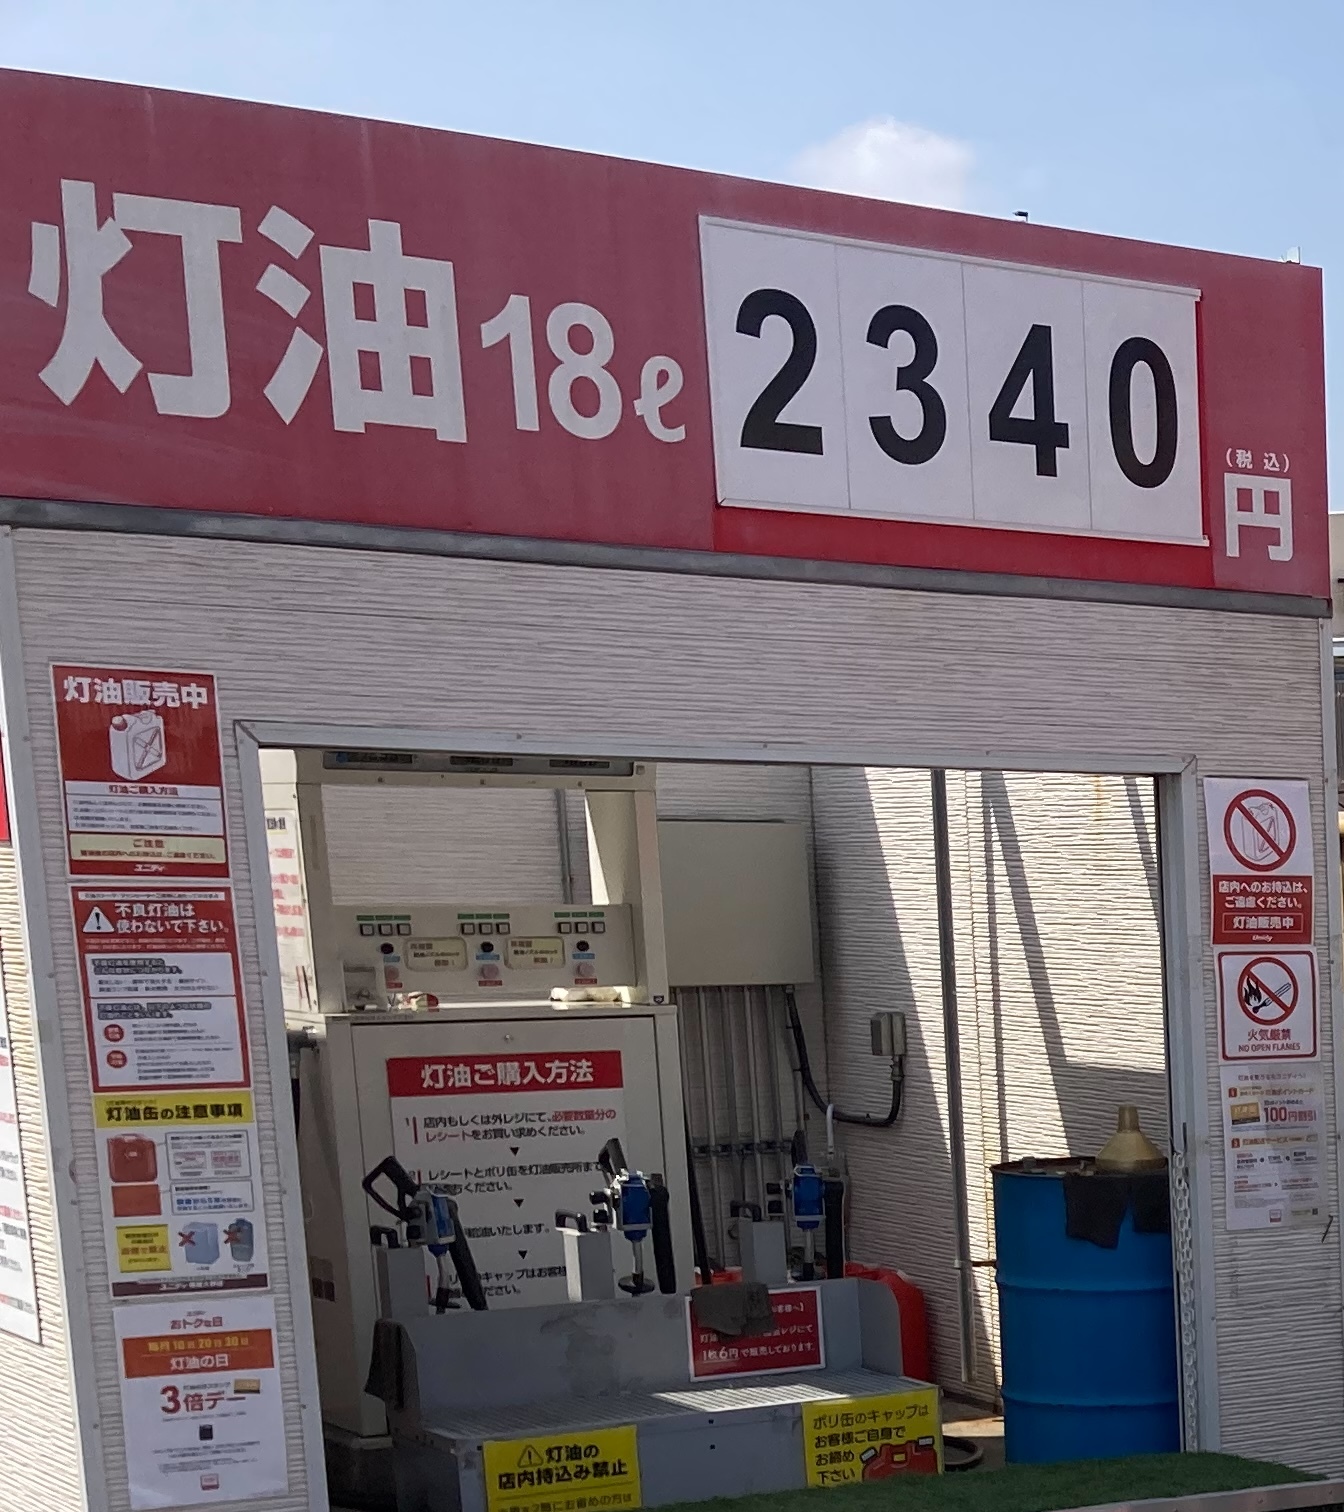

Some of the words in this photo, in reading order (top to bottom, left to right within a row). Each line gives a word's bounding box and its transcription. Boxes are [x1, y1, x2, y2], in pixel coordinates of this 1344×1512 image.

[28, 179, 466, 443] 灯油
[735, 289, 1177, 489] 2340
[1223, 472, 1293, 561] 円
[63, 676, 207, 708] 灯油販売中
[1218, 880, 1308, 894] 店内へのお持込は、
[115, 903, 195, 916] 不良灯油は
[116, 920, 229, 933] 使わないで下さい。
[1232, 915, 1294, 930] 灯油販売中
[1248, 1028, 1291, 1042] 火気厳禁
[1251, 1043, 1271, 1051] OPEN
[1272, 1042, 1300, 1050] FLAMES
[421, 1058, 594, 1089] 灯油ご購入方法
[106, 1103, 243, 1122] 灯油缶の注意事項
[425, 1126, 585, 1142] レシートをお買い求めください。
[170, 1354, 229, 1371] 灯油の日
[813, 1404, 929, 1430] ポリ缶のキャップは
[815, 1426, 906, 1448] お客様ご自身で
[546, 1444, 599, 1463] 灯油の
[498, 1458, 628, 1489] 店内持込み禁止
[817, 1468, 855, 1484] 下さい
